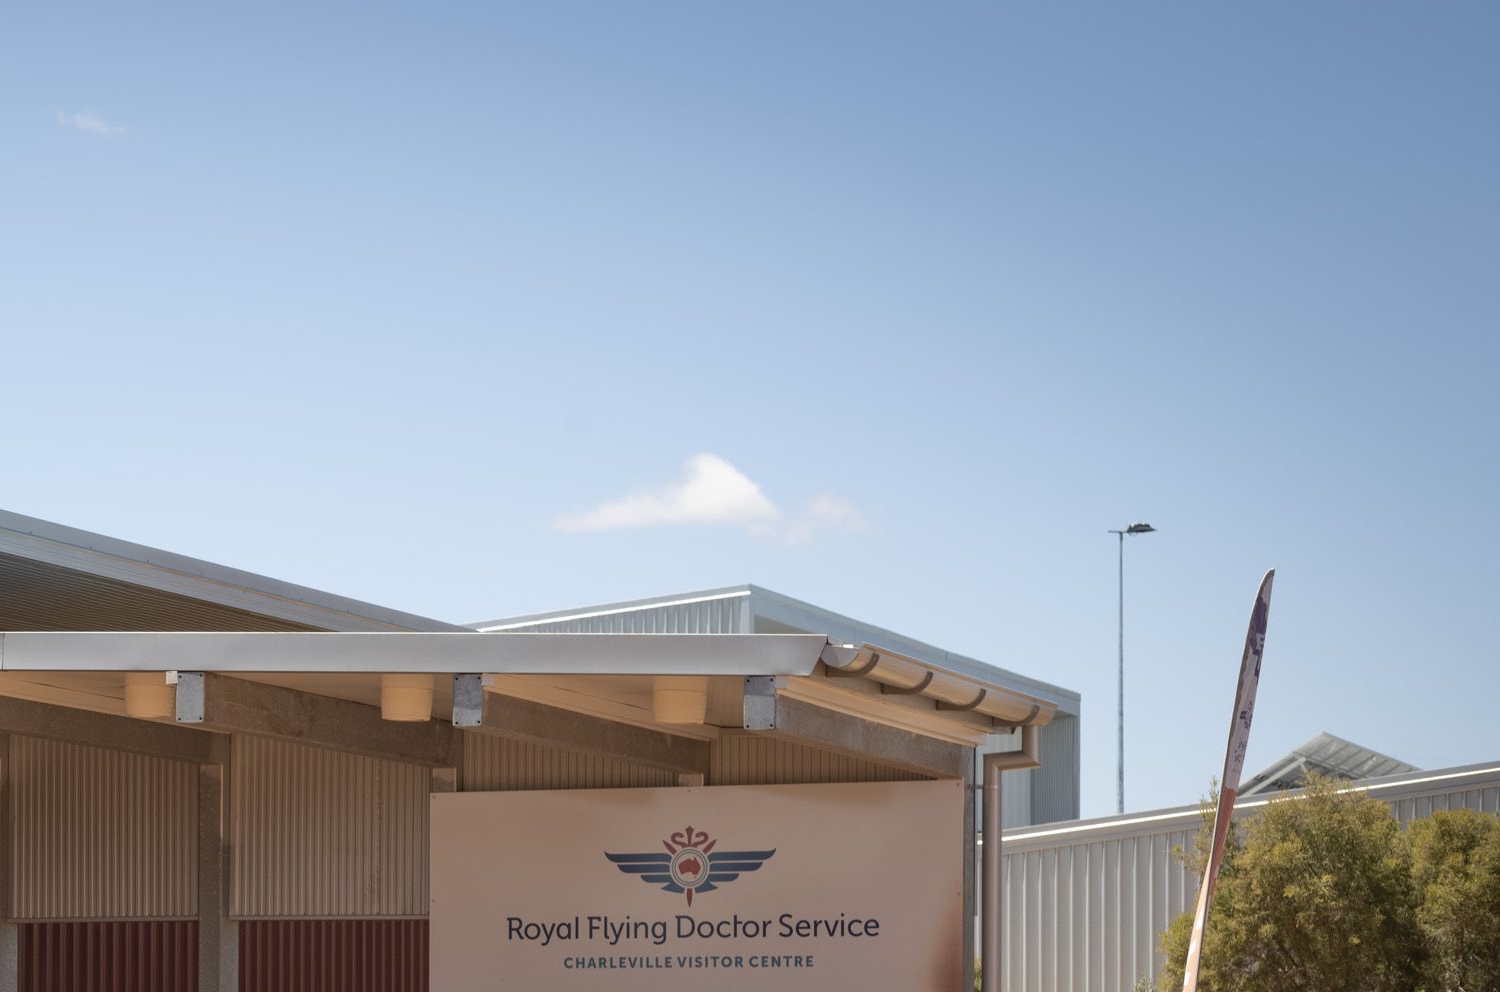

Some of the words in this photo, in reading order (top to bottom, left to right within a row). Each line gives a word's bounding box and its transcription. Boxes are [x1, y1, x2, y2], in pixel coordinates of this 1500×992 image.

[507, 917, 578, 946] Royal
[588, 916, 666, 945] Flying
[676, 915, 772, 938] Doctor
[779, 913, 879, 937] Service
[564, 957, 672, 968] CHARLEVILLE
[677, 956, 743, 968] VISITOR
[749, 956, 813, 967] CENTRE
